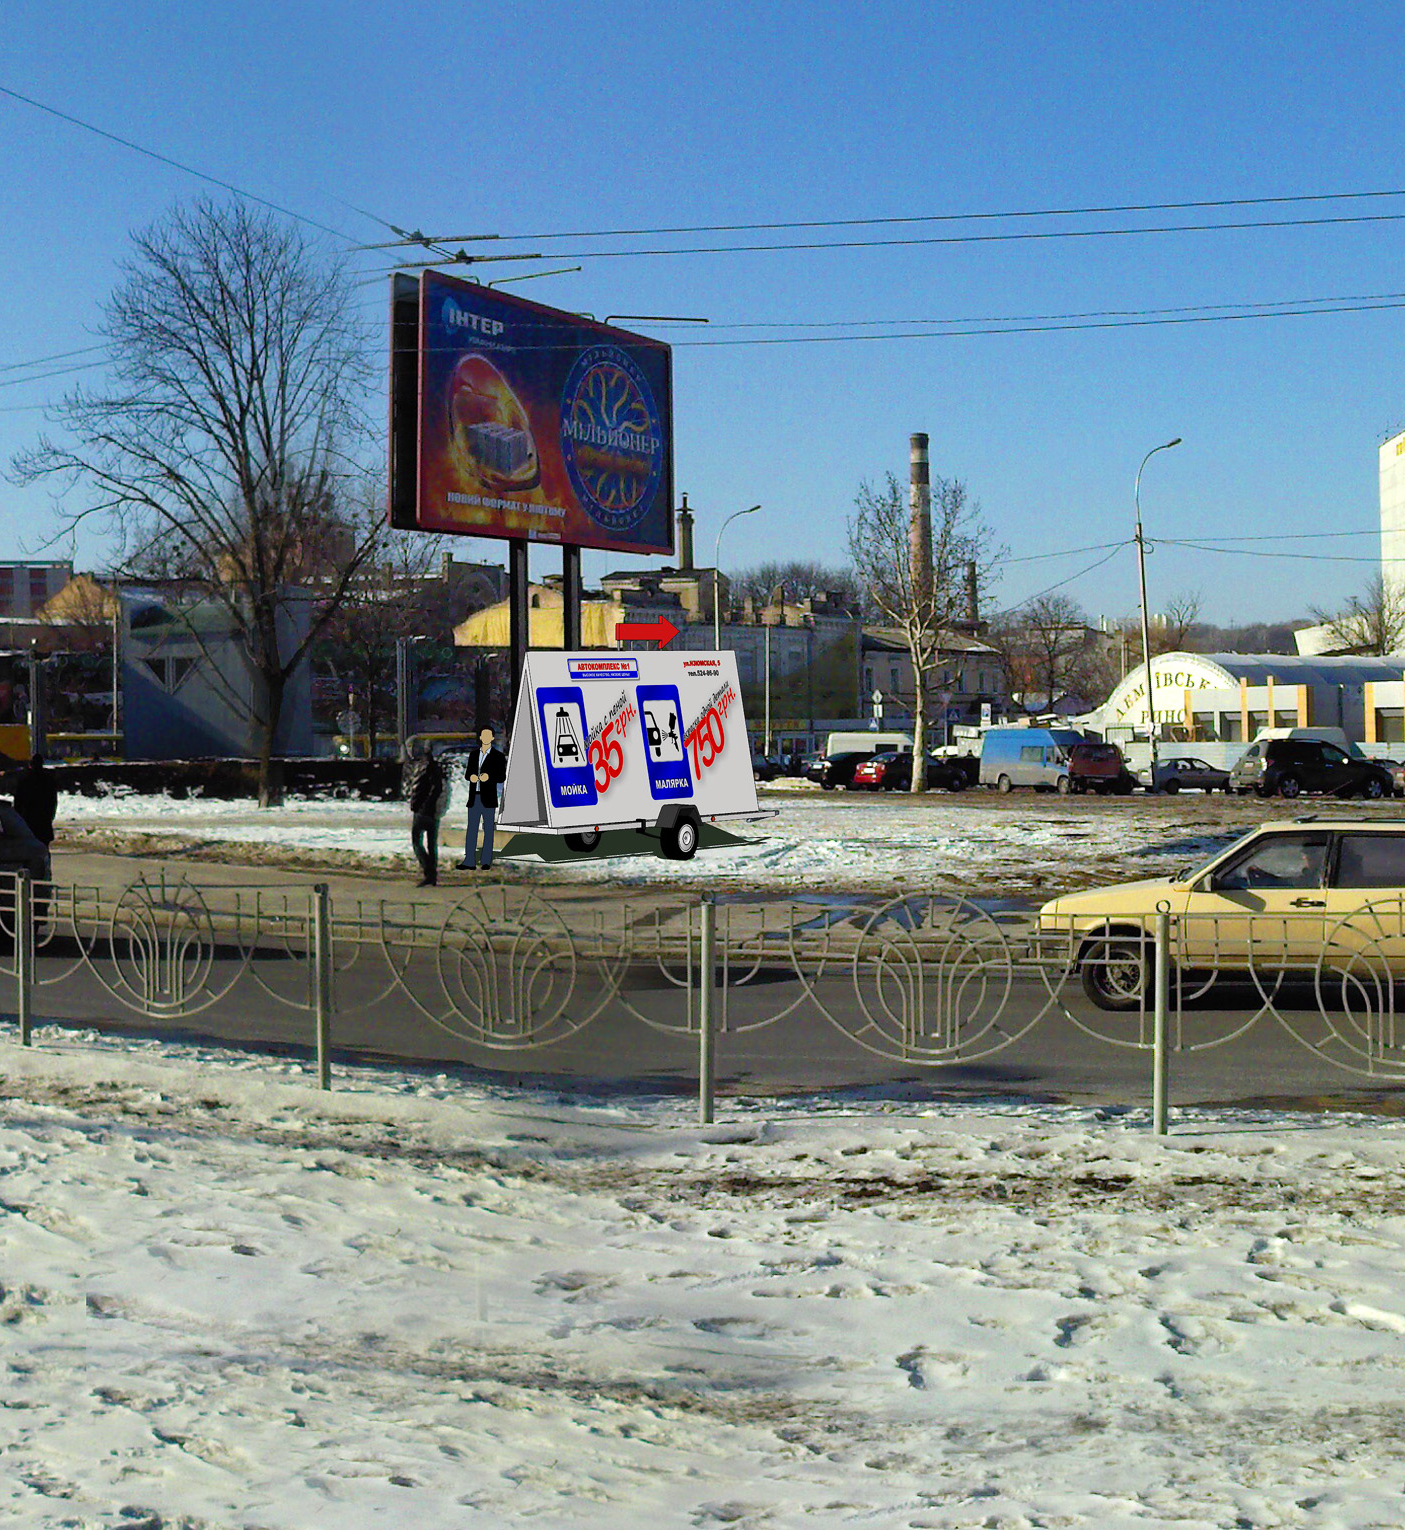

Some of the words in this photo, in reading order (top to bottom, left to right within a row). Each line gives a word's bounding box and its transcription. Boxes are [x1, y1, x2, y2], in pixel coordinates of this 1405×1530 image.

[448, 308, 504, 336] ІНТЕР
[562, 417, 660, 455] МІЛЬЙОНЕР
[447, 491, 481, 506] НОВИЙ
[482, 496, 520, 512] ФОРМАТ
[528, 503, 567, 518] ЛЮТОМУ
[578, 663, 620, 671] АВТОКОМПЛЕКС
[684, 707, 725, 780] 750
[718, 687, 736, 719] грн.
[588, 721, 624, 793] 35
[615, 703, 637, 738] грн.
[560, 783, 588, 796] МОЙКА
[655, 778, 689, 789] МАЛЯРКА
